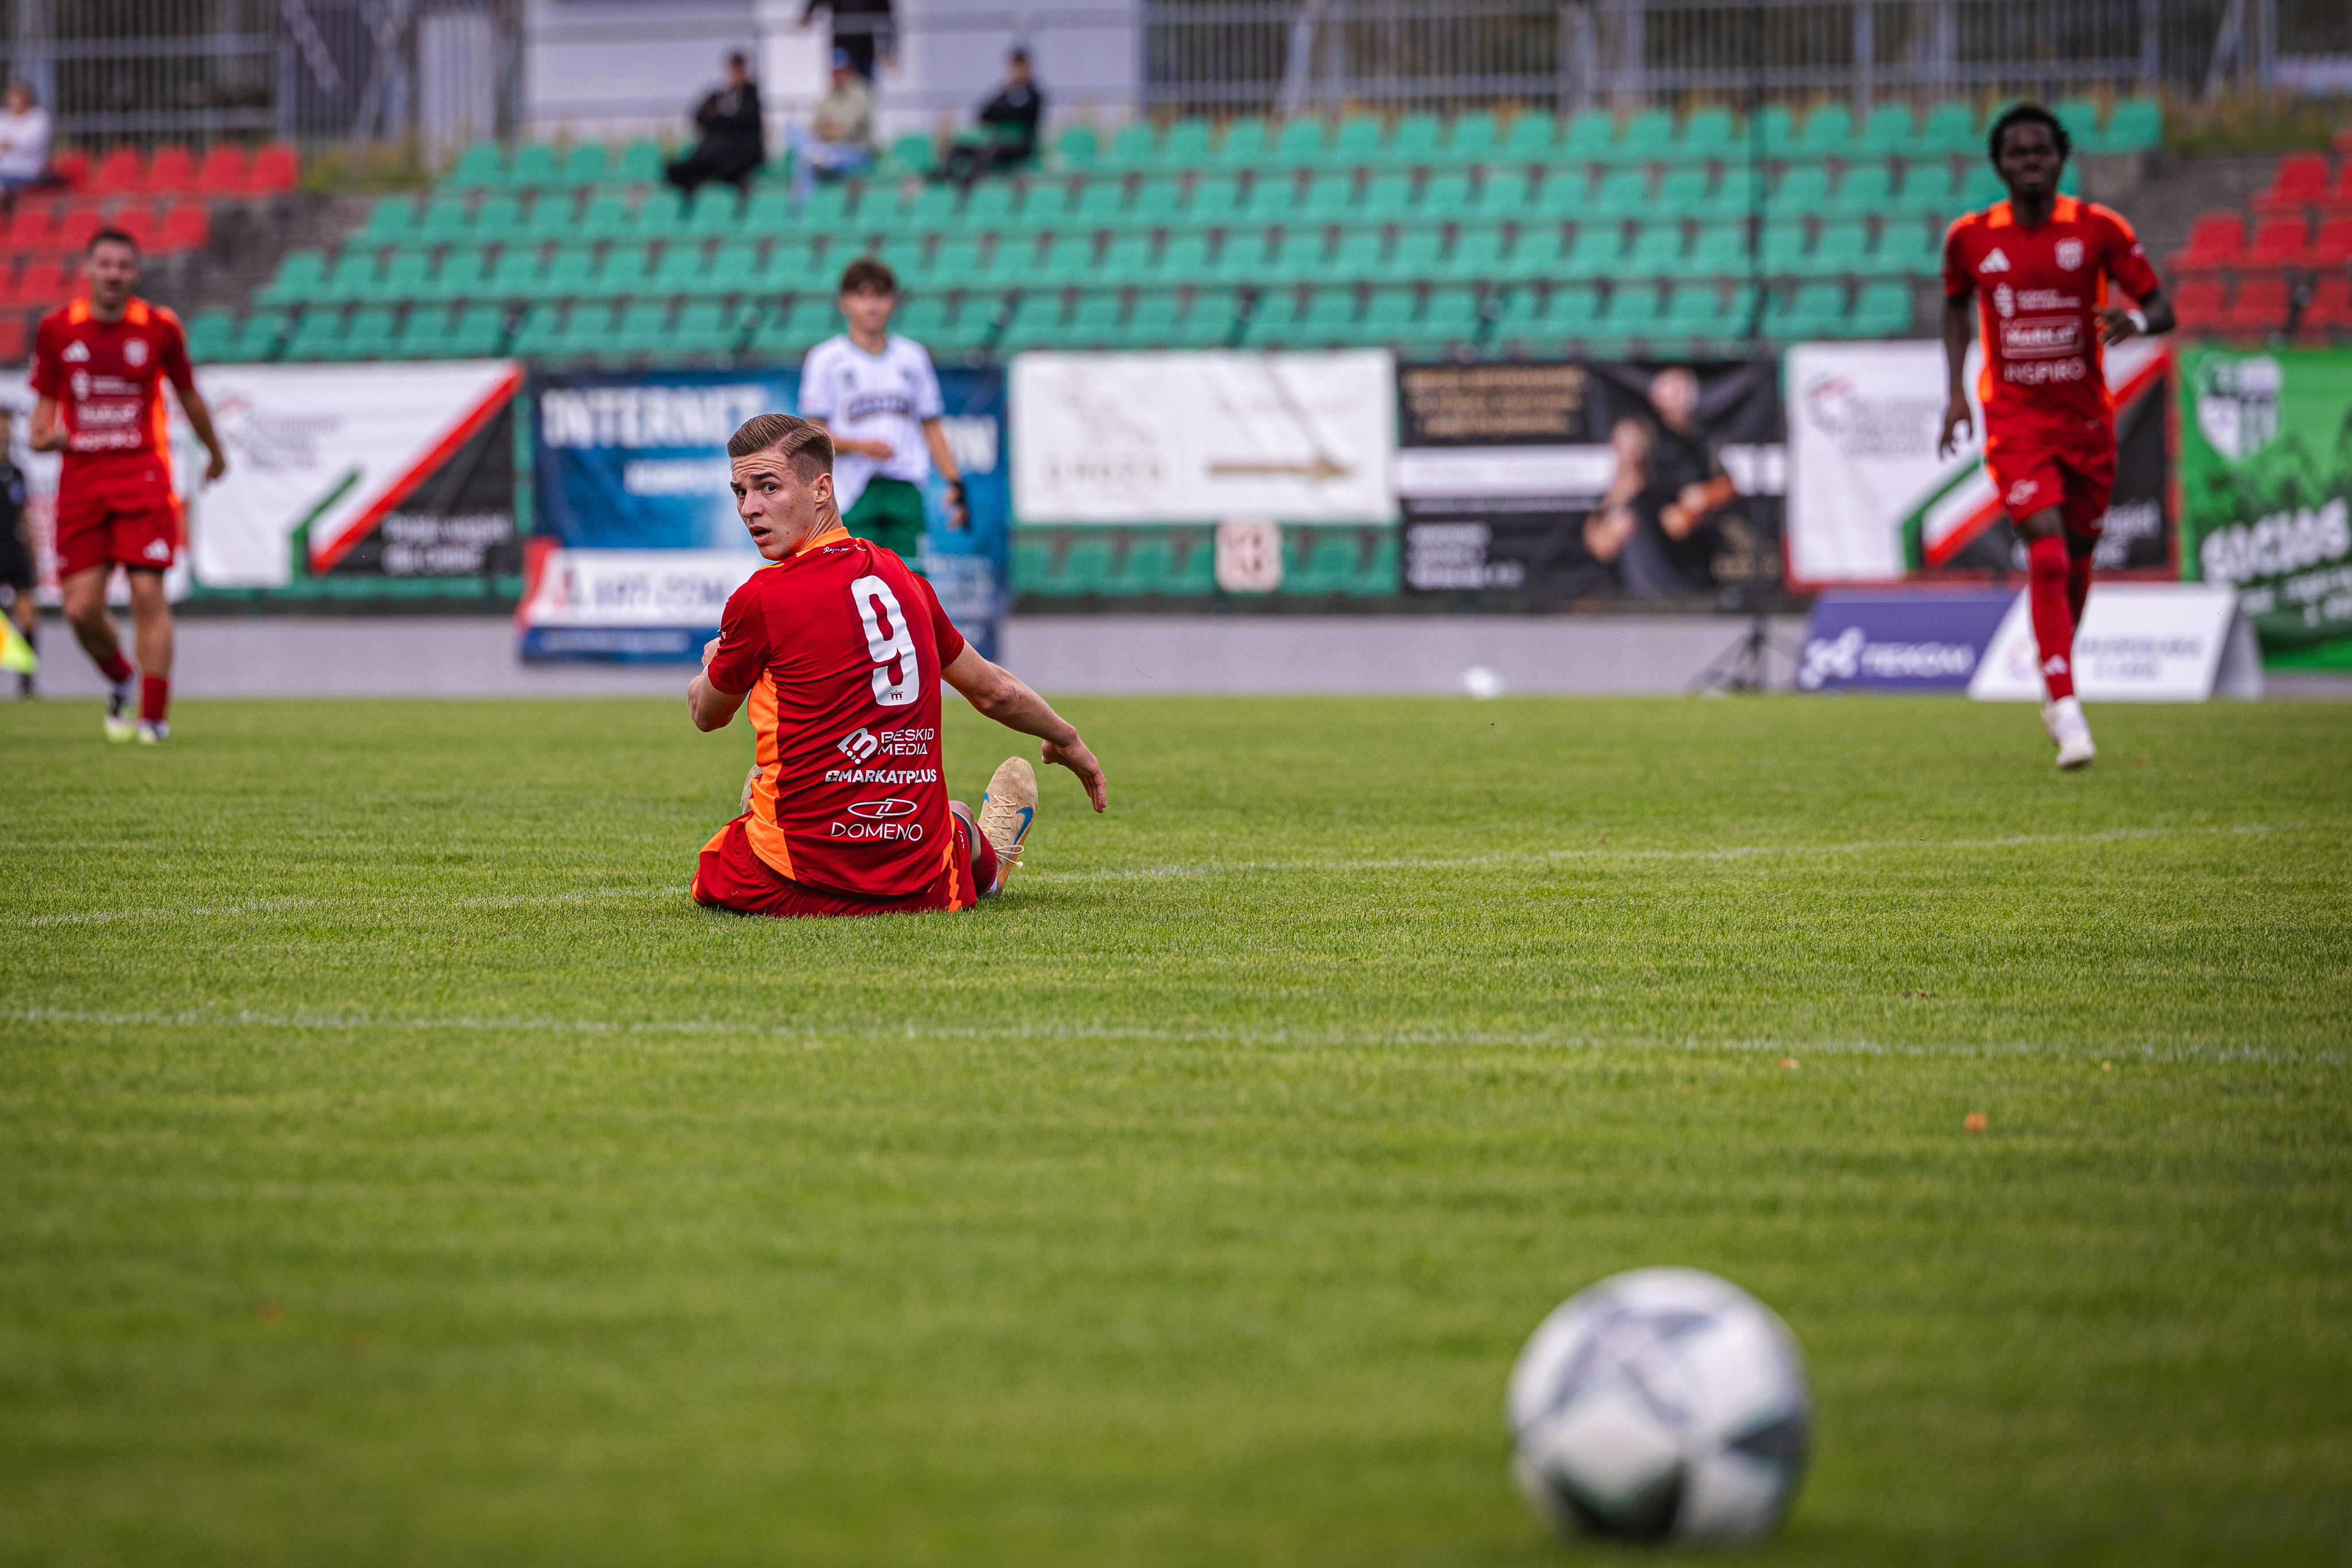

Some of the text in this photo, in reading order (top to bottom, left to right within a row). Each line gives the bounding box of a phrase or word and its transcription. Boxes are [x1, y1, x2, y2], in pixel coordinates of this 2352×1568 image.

[851, 575, 919, 706] 9
[881, 728, 934, 743] BESKID
[877, 743, 928, 755] MEDIA
[838, 769, 937, 784] MARKATPLUS
[830, 822, 923, 841] DOMENO
